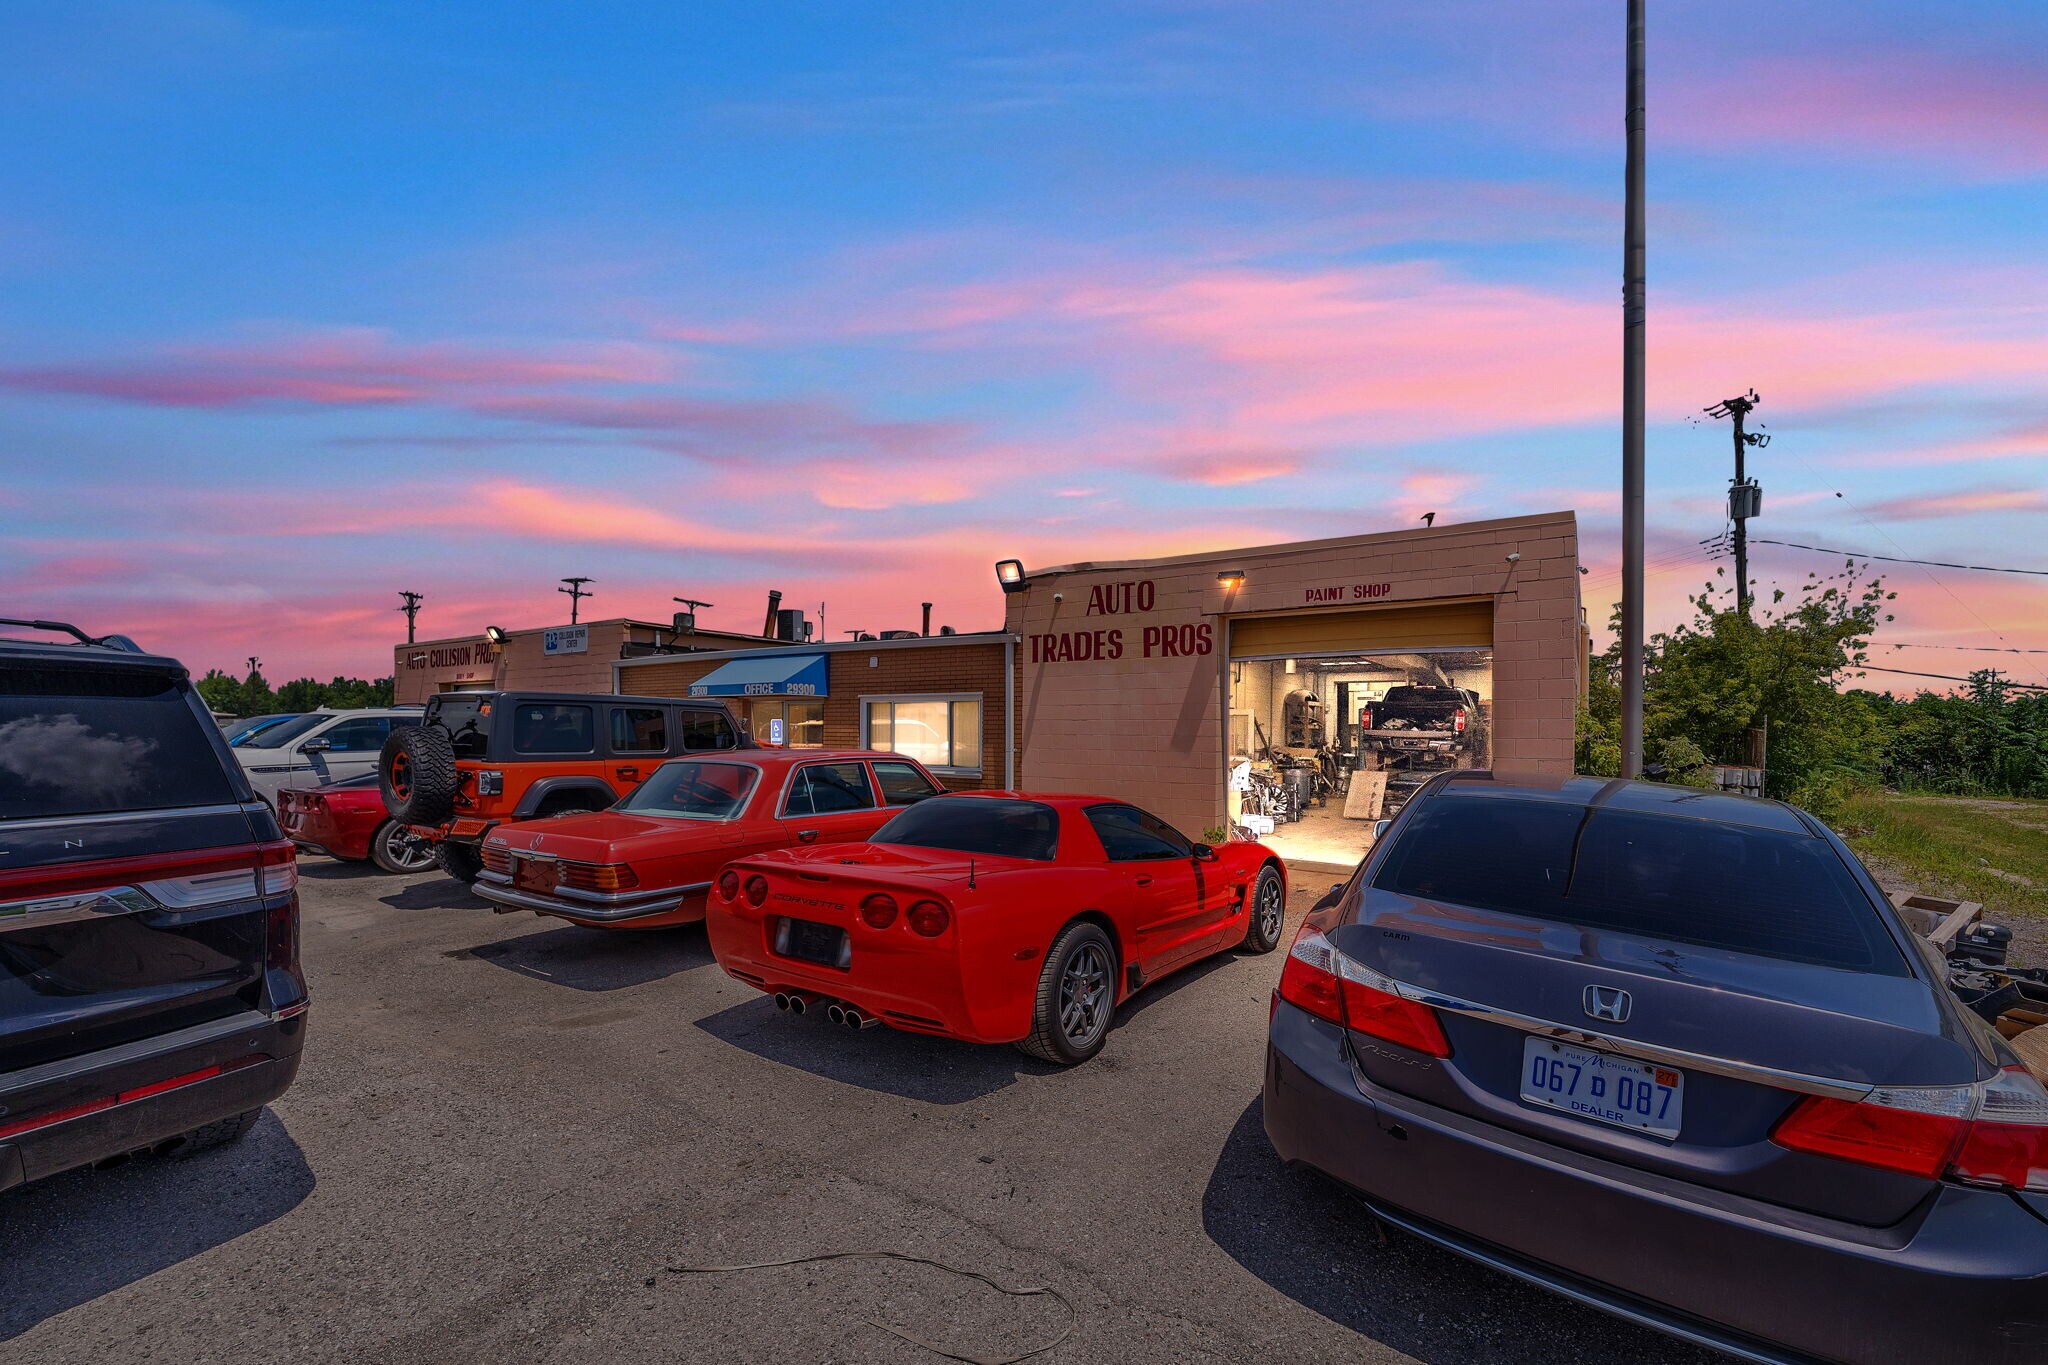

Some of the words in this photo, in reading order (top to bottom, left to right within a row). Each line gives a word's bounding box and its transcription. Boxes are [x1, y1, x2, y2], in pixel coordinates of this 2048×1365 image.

[1086, 580, 1155, 616] AUTO
[1305, 587, 1345, 602] PAINT
[1353, 584, 1391, 599] SHOP
[1029, 629, 1123, 663] TRADES
[1143, 623, 1213, 658] PROS
[406, 652, 425, 670] AUTO
[430, 646, 471, 668] COLLISION
[744, 683, 773, 694] OFFICE
[786, 683, 815, 695] 29300
[774, 893, 846, 910] CORVETTE
[1565, 1052, 1586, 1062] PURE
[1657, 1071, 1671, 1081] 27
[1532, 1056, 1581, 1096] 067
[1590, 1076, 1606, 1098] D
[1617, 1076, 1672, 1120] 087
[1571, 1100, 1624, 1122] DEALER
